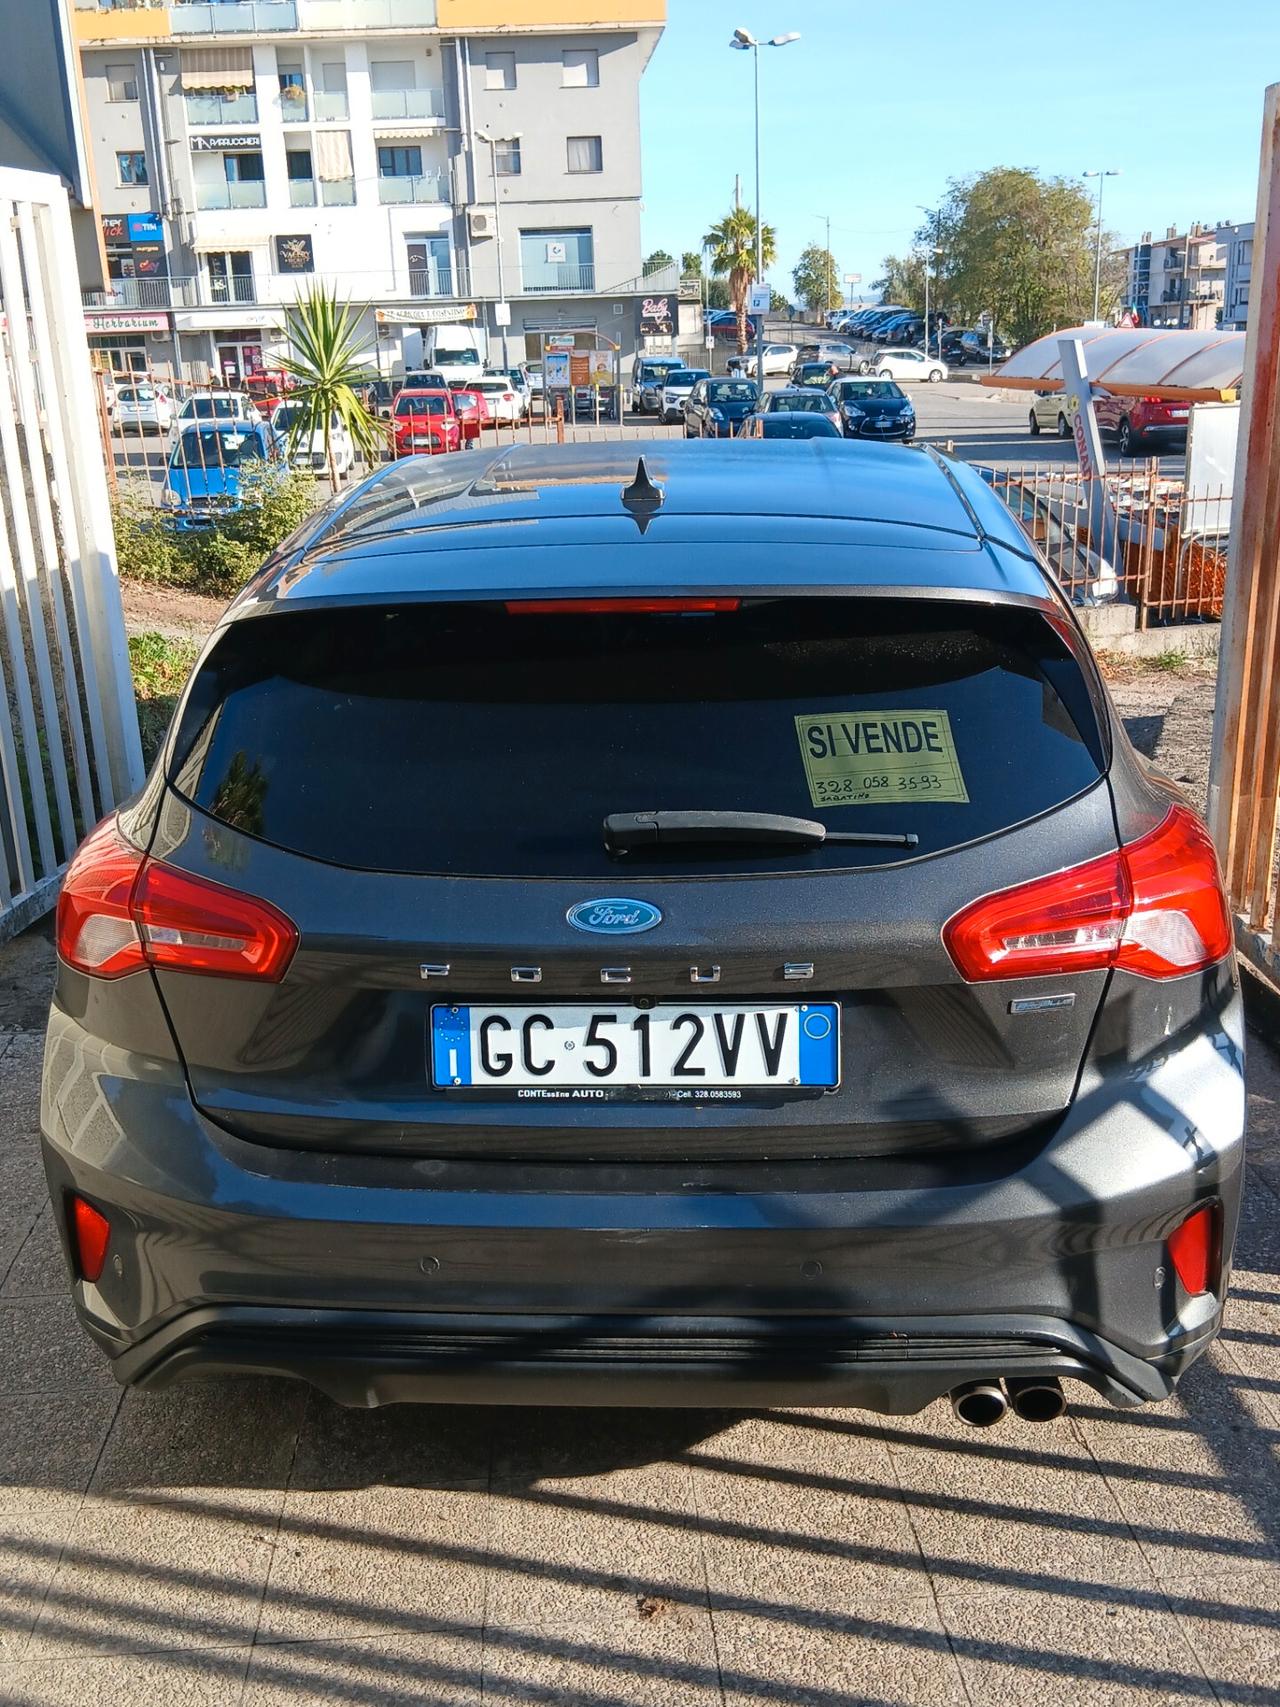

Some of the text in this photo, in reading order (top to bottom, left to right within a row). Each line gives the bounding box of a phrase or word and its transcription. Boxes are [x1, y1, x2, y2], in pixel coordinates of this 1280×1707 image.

[642, 299, 671, 320] Baby
[93, 316, 159, 330] Herbarium
[807, 721, 943, 759] SI VENDE
[815, 775, 942, 794] 328 058 3593
[589, 905, 640, 925] Ford
[420, 962, 814, 983] FOCUS
[572, 1089, 604, 1097] AUTO
